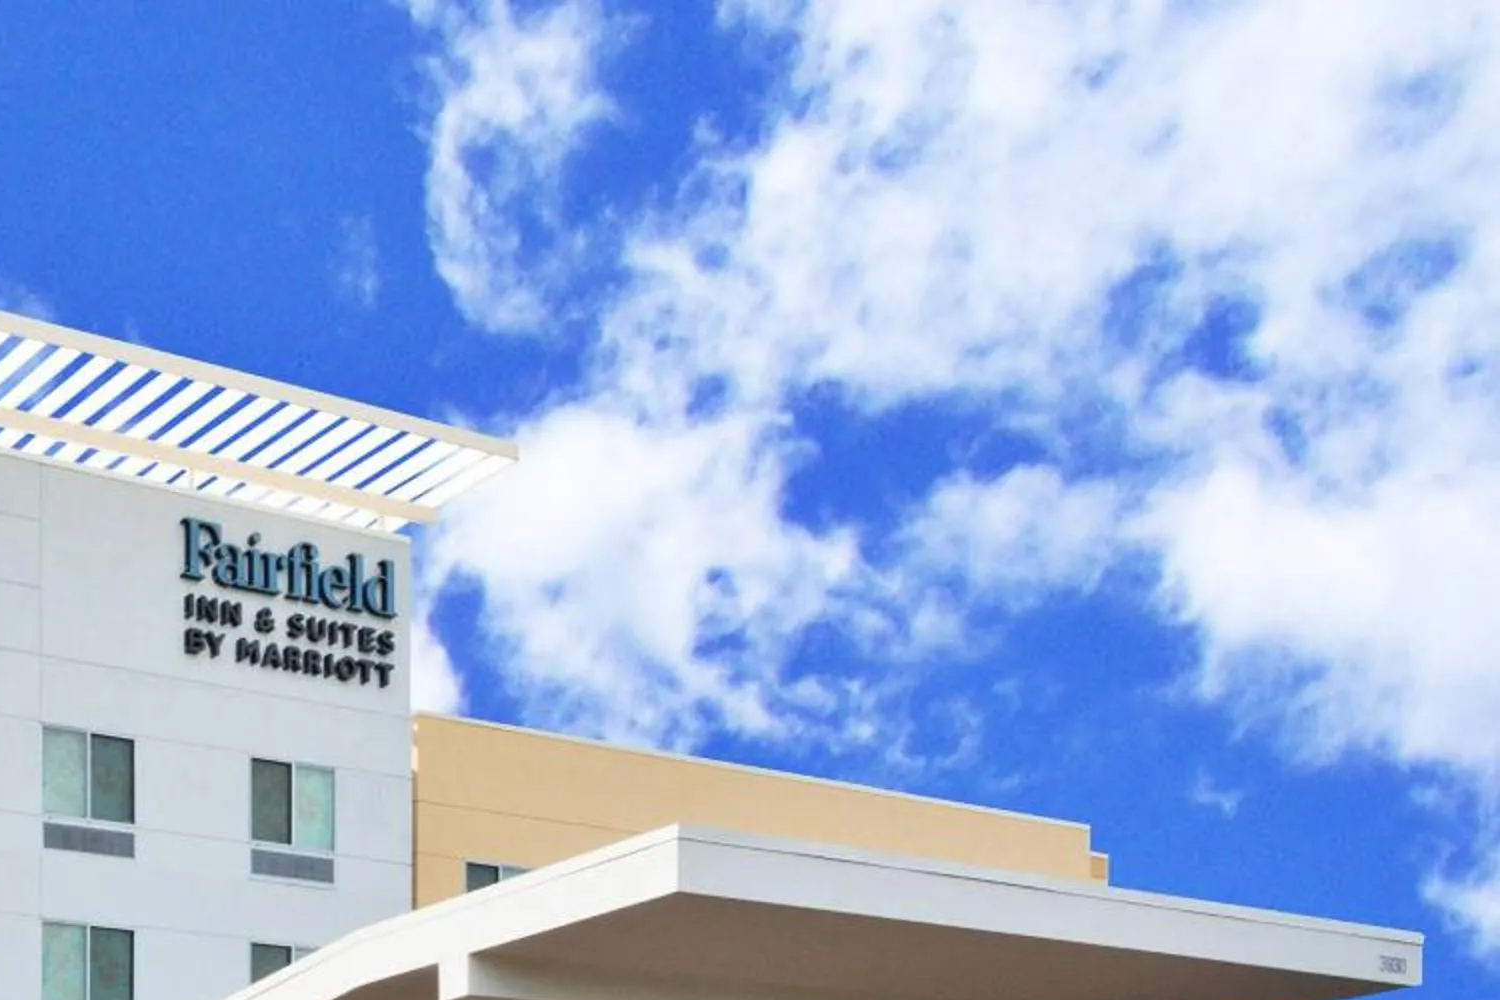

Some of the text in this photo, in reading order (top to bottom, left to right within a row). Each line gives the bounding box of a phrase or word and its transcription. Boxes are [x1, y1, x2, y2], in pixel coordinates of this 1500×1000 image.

[180, 516, 398, 620] Fairfield
[184, 593, 396, 656] INN & SUITES
[184, 627, 395, 689] BY MARRIOTT
